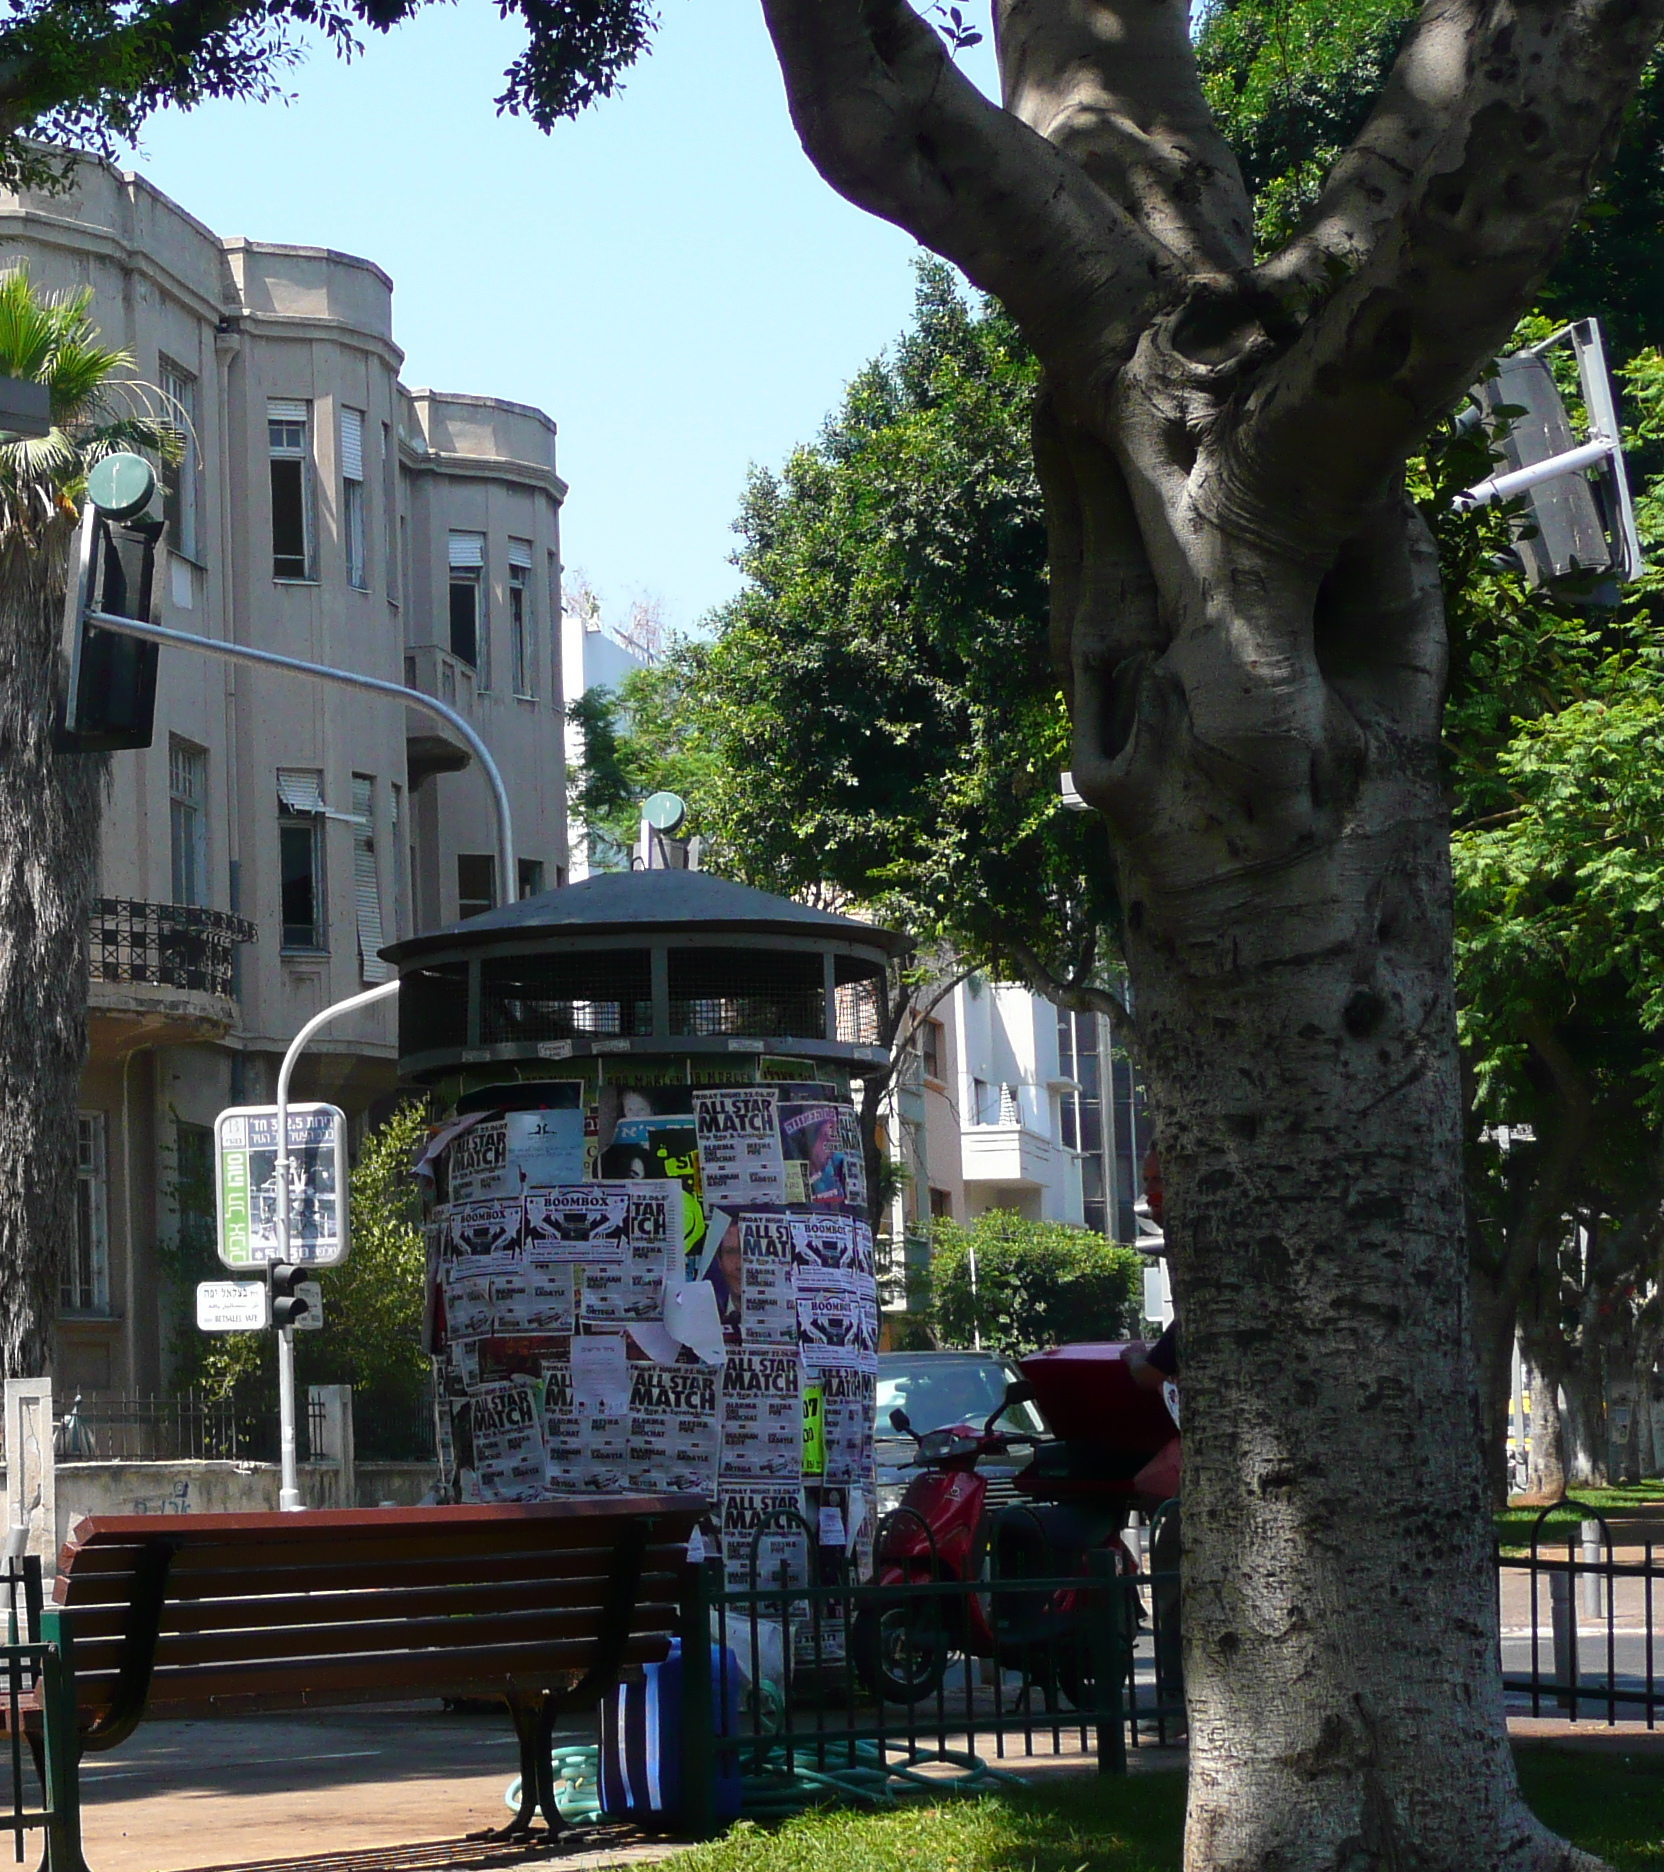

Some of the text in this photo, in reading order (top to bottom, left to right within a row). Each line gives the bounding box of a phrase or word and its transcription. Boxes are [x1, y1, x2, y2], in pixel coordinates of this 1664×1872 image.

[699, 1099, 772, 1114] ALL STAR
[698, 1113, 774, 1133] MATCH
[473, 1132, 506, 1150] STAR
[451, 1145, 506, 1173] MATCH
[227, 1153, 244, 1187] סוהו
[225, 1193, 245, 1218] תל
[544, 1197, 610, 1207] BOOMBOX
[632, 1202, 666, 1217] TAR
[460, 1210, 506, 1223] BOOMBOX
[744, 1224, 772, 1239] ALL
[229, 1223, 246, 1263] אביב
[204, 1289, 218, 1298] יפה
[221, 1287, 248, 1298] בצלאל
[725, 1357, 797, 1374] ALL STAR
[634, 1373, 714, 1392] ALL STAR
[722, 1372, 798, 1392] MATCH
[474, 1397, 489, 1413] ALL
[491, 1390, 530, 1410] STAR
[629, 1387, 715, 1410] MATCH
[474, 1404, 533, 1432] MATCH
[726, 1496, 799, 1511] ALL STAR
